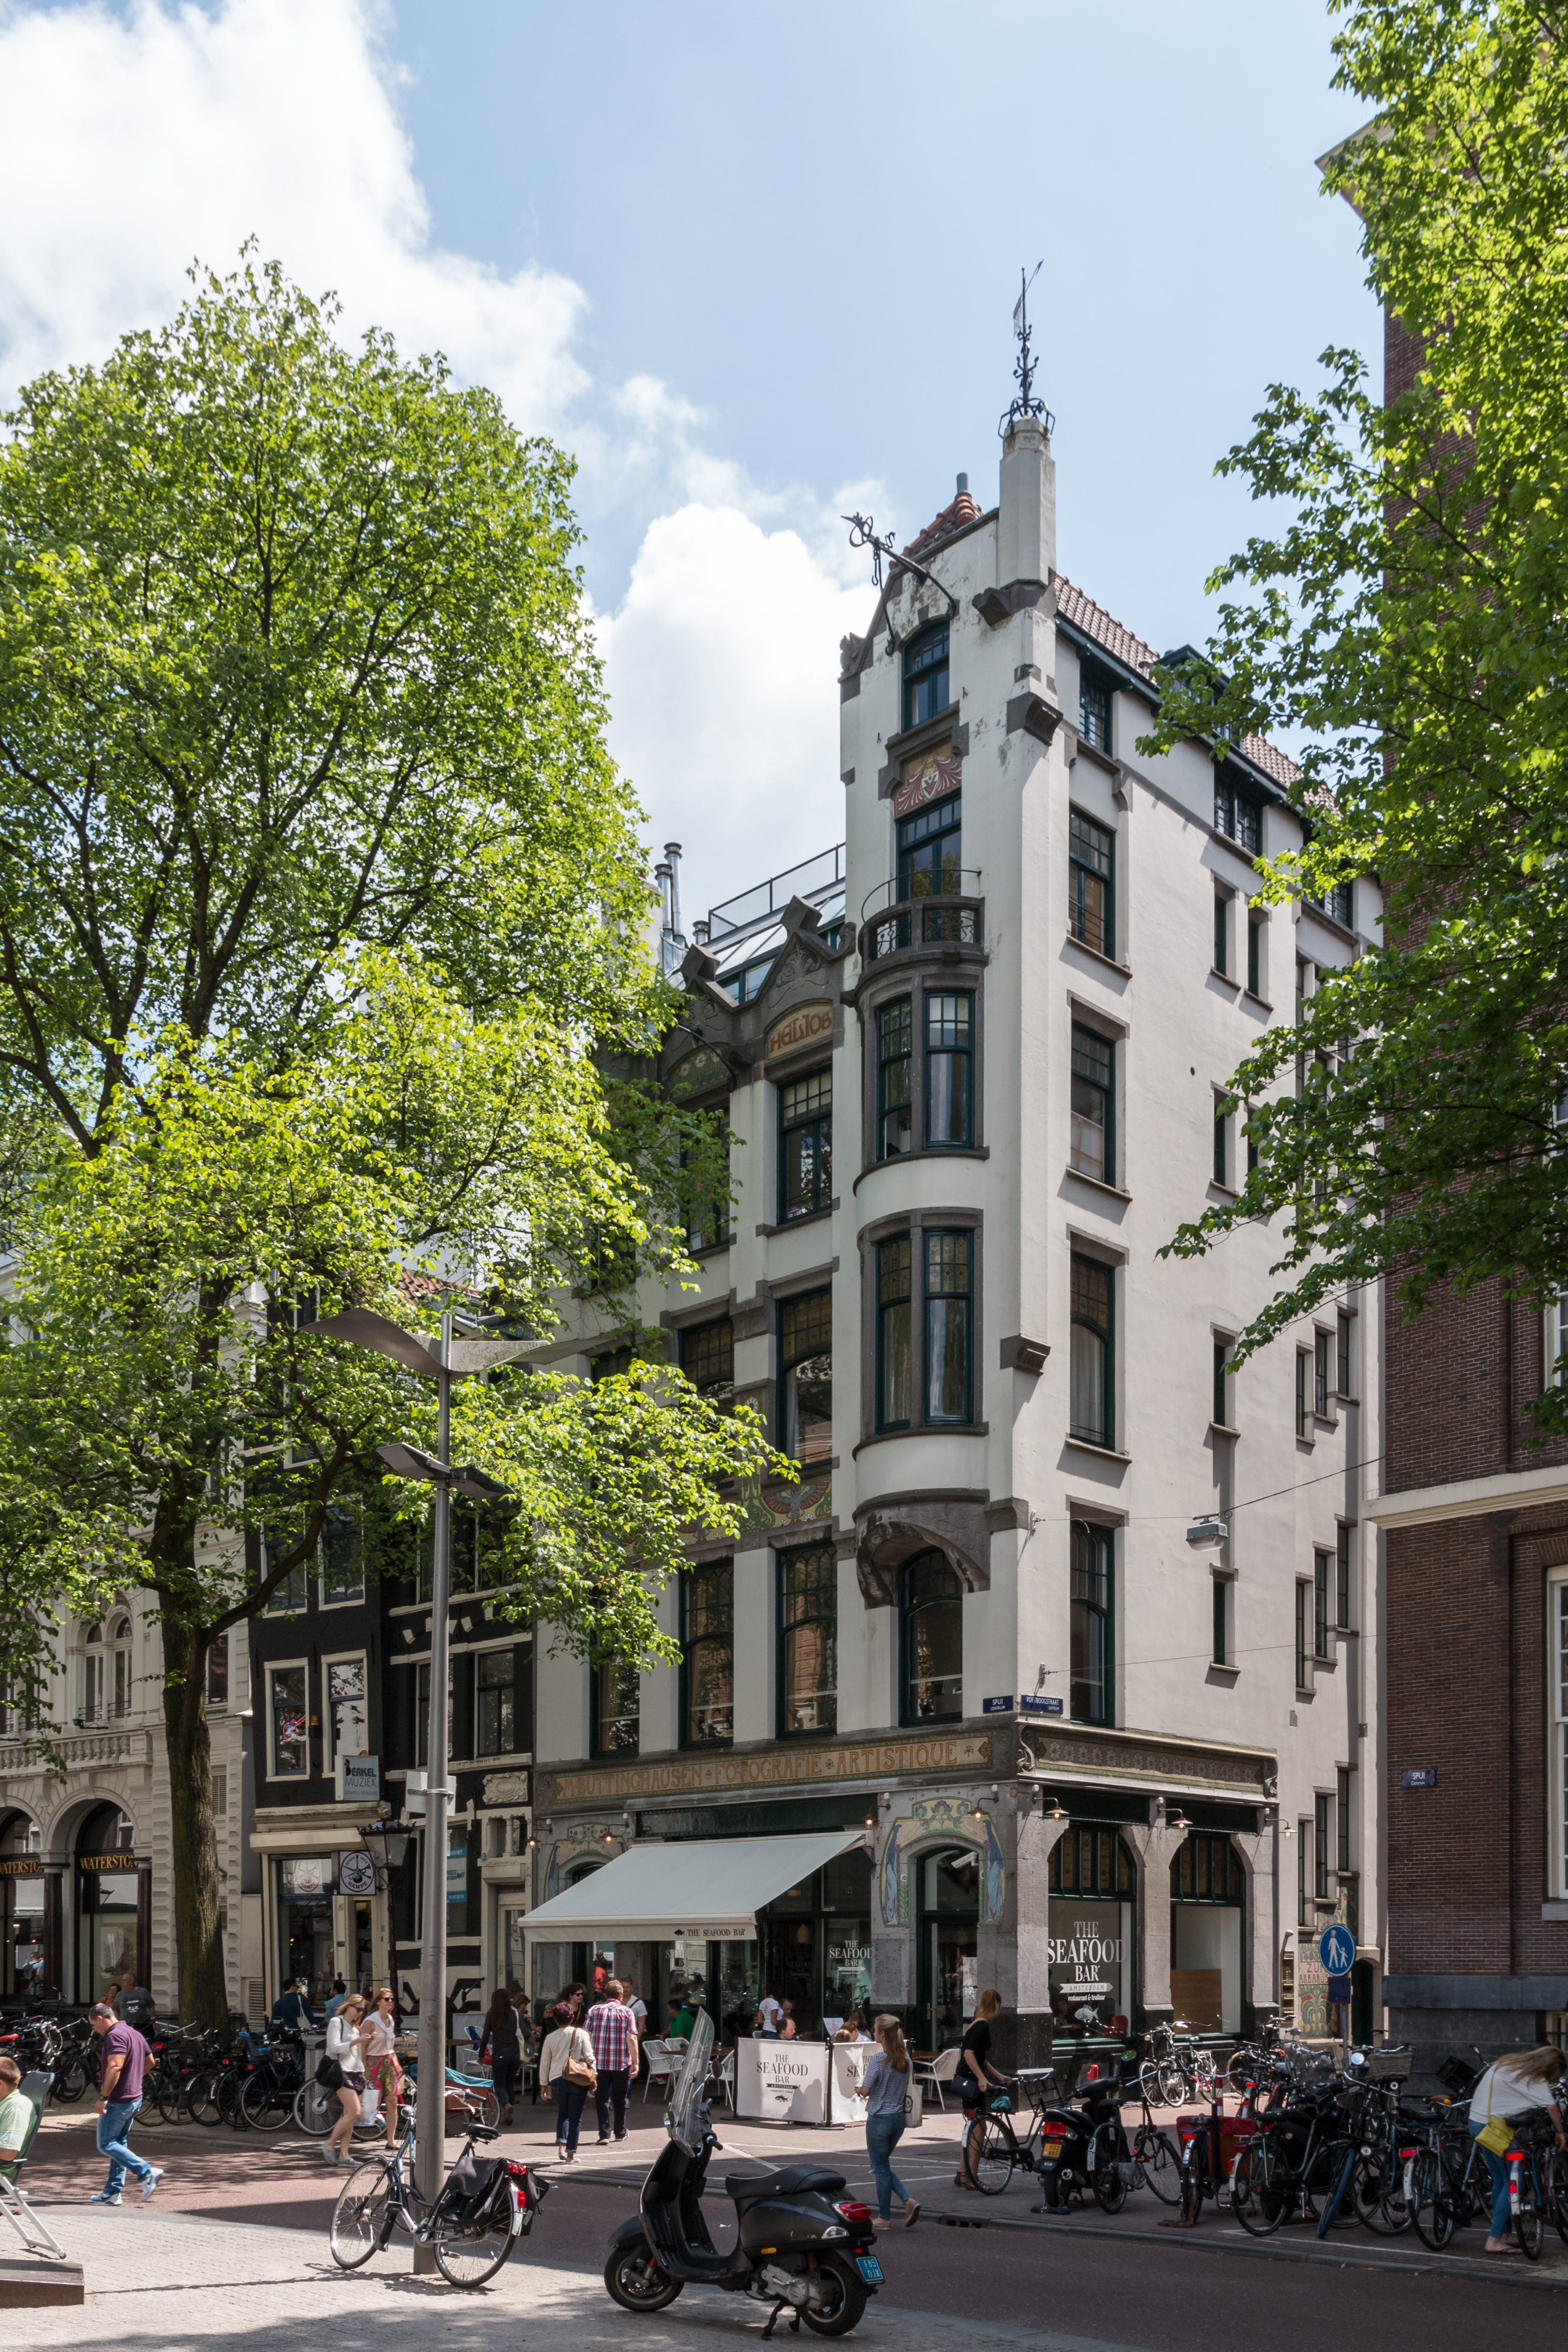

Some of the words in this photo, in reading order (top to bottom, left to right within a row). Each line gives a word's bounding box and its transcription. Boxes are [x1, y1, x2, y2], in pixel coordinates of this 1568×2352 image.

[770, 1013, 832, 1052] HELIOS
[1026, 1696, 1059, 1705] VOETBOOGSTRAAT
[345, 1759, 377, 1777] BERKEL
[715, 1754, 822, 1784] FOTOGRAFIE
[837, 1742, 958, 1775] ARTISTIQUE
[345, 1777, 377, 1787] MUZIEK
[348, 1881, 368, 1889] HAMPE
[703, 1928, 730, 1937] SEAFOOD
[1074, 1921, 1099, 1938] THE
[829, 1948, 872, 1958] SEAFOOD
[1047, 1939, 1126, 1964] SEAFOOD
[1298, 1974, 1331, 1983] ARBAROS
[774, 2054, 790, 2063] THE
[756, 2061, 808, 2076] SEAFOOD
[775, 2075, 790, 2084] BAR
[863, 2259, 876, 2268] F85
